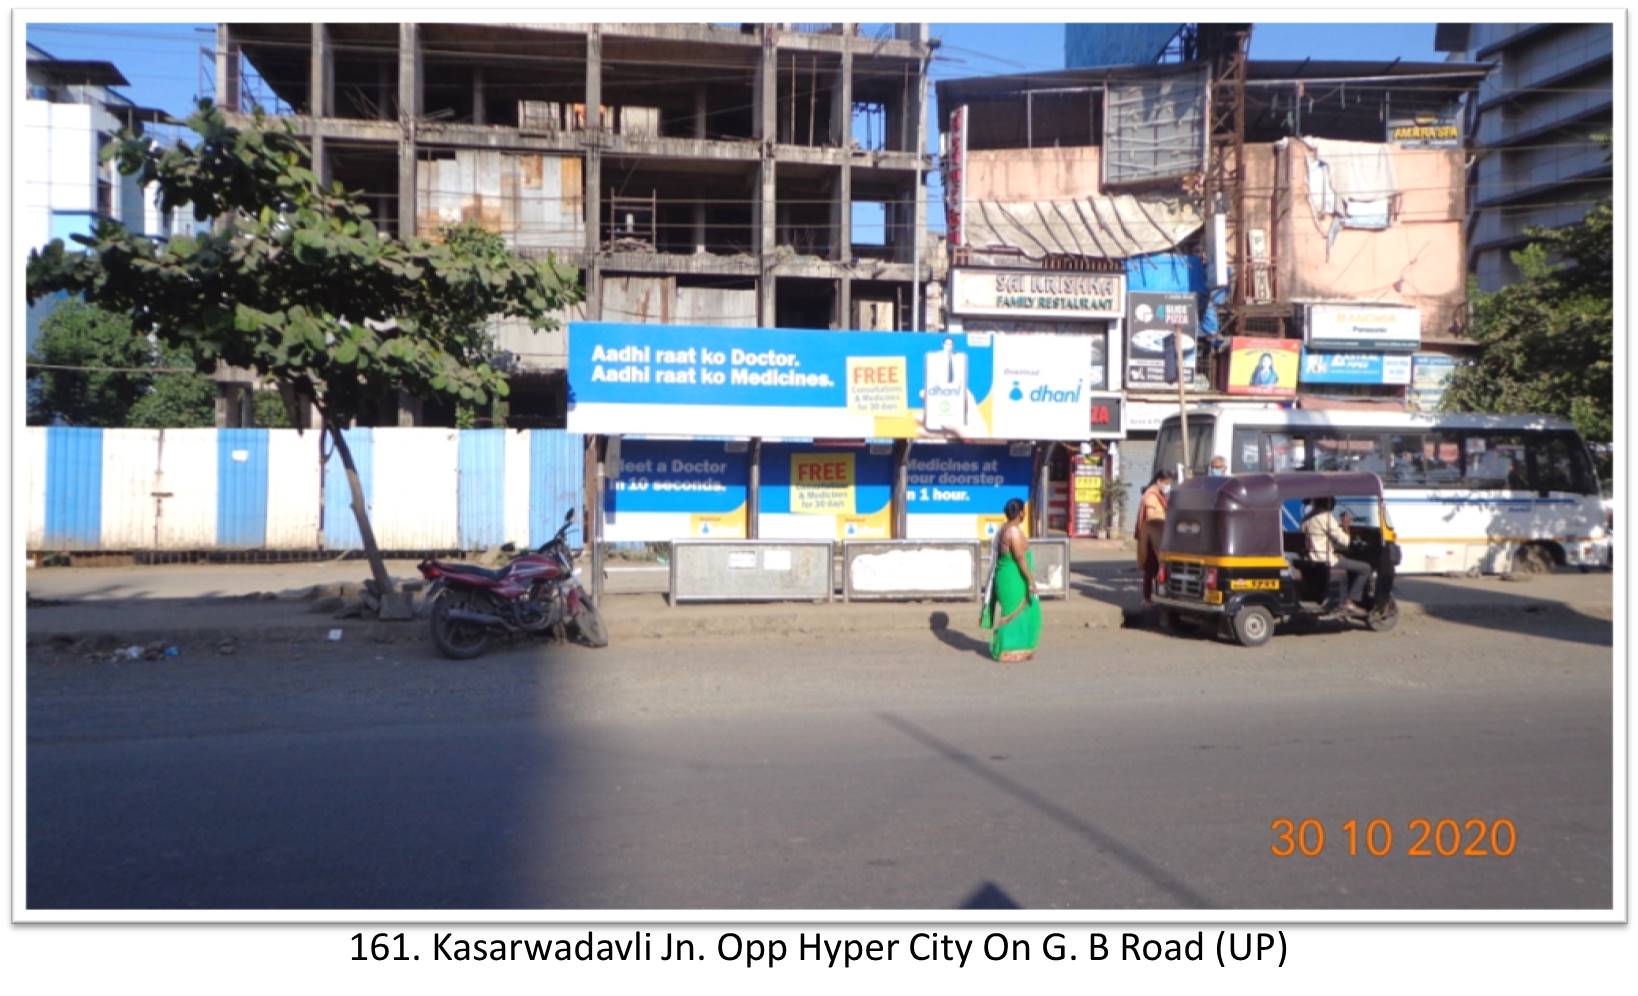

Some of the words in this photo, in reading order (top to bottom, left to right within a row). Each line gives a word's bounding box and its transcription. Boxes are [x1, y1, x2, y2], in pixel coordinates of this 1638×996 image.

[996, 296, 1037, 308] FAMILY
[1039, 297, 1113, 311] RESTAURANT
[592, 345, 650, 363] Aadhi
[655, 348, 696, 364] raat
[701, 348, 726, 364] ko
[731, 349, 800, 367] Doctor.
[592, 365, 650, 383] Aadhi
[655, 367, 696, 384] raat
[701, 368, 726, 384] ko
[731, 368, 834, 387] Medicines.
[853, 366, 899, 384] FREE
[1029, 378, 1083, 403] dhani
[657, 463, 667, 473] a
[671, 460, 728, 473] Doctor
[798, 463, 847, 481] FREE
[982, 459, 998, 472] at
[628, 478, 650, 491] 10
[652, 479, 727, 492] seconds.
[938, 471, 1004, 488] doorstep
[919, 487, 929, 500] 1
[932, 487, 970, 501] hour.
